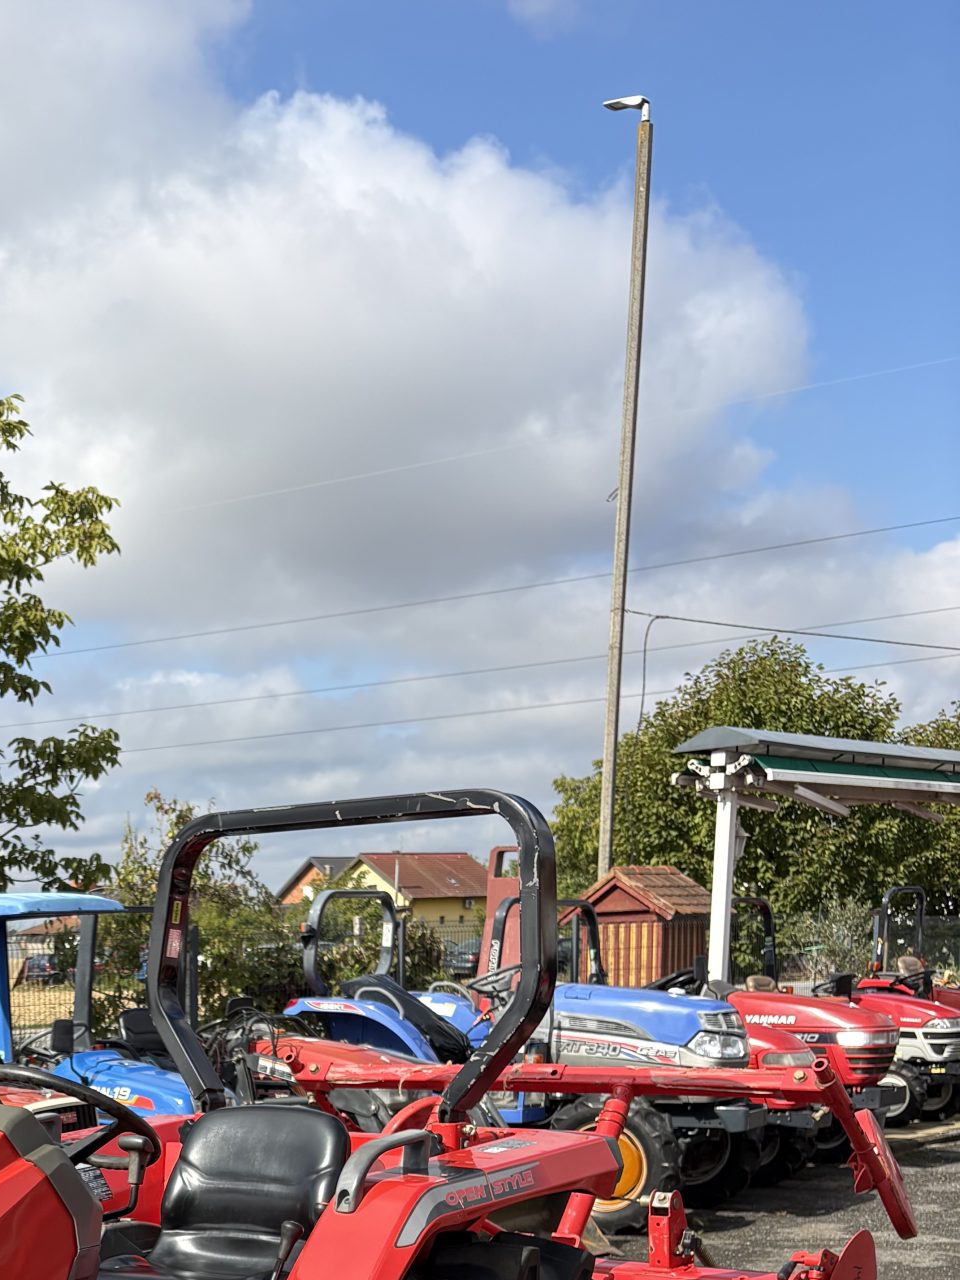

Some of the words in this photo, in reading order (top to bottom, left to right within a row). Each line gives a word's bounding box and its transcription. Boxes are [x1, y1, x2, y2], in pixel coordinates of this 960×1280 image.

[744, 1014, 797, 1025] YANMAR
[444, 1185, 487, 1206] OPEN
[492, 1170, 535, 1195] STYLE
